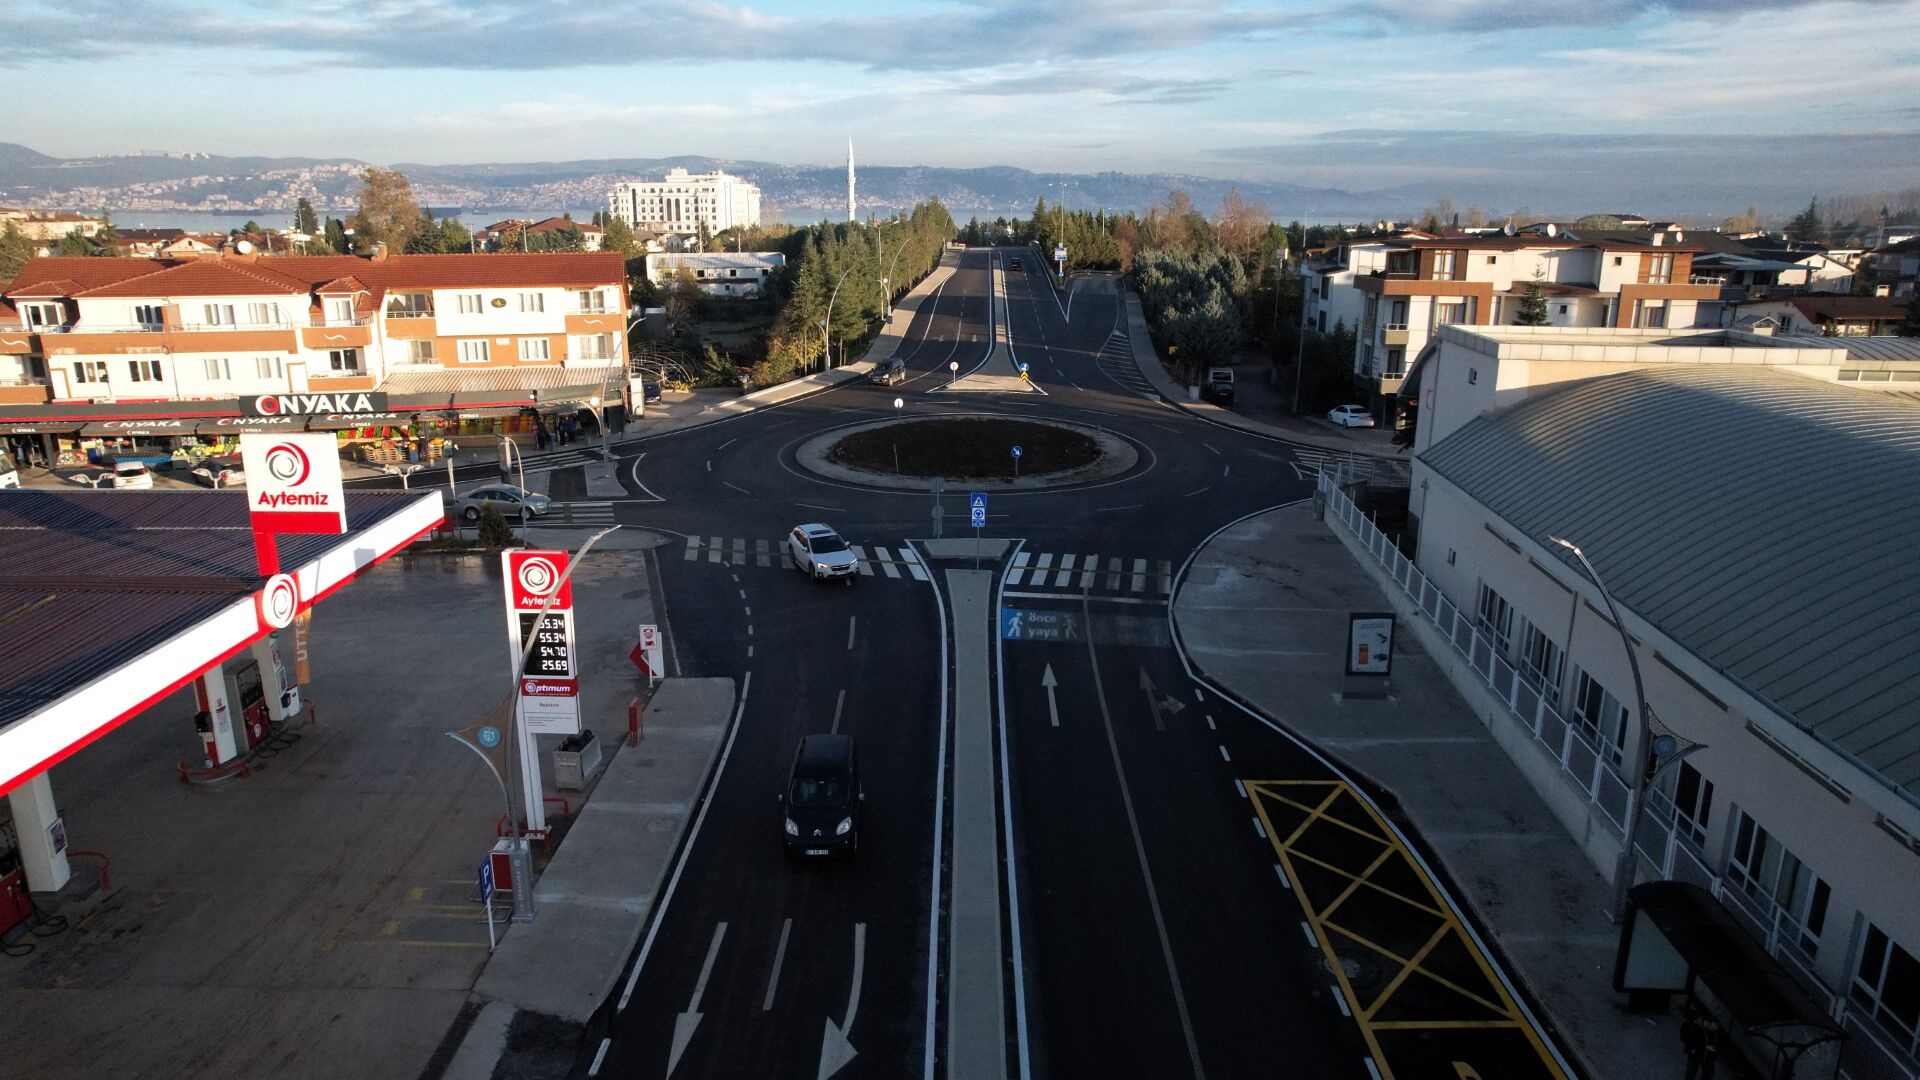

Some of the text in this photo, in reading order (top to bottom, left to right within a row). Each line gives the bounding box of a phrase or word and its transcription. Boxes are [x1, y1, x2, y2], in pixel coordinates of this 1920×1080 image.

[255, 393, 374, 416] ONYAKA
[216, 417, 292, 426] ONYAKA
[258, 491, 328, 508] Aytemiz
[1028, 612, 1057, 623] önce
[540, 632, 566, 643] 55.34
[1028, 626, 1058, 638] yaya
[541, 646, 567, 657] 54.70
[542, 660, 568, 671] 25.69
[525, 682, 570, 694] Optimum
